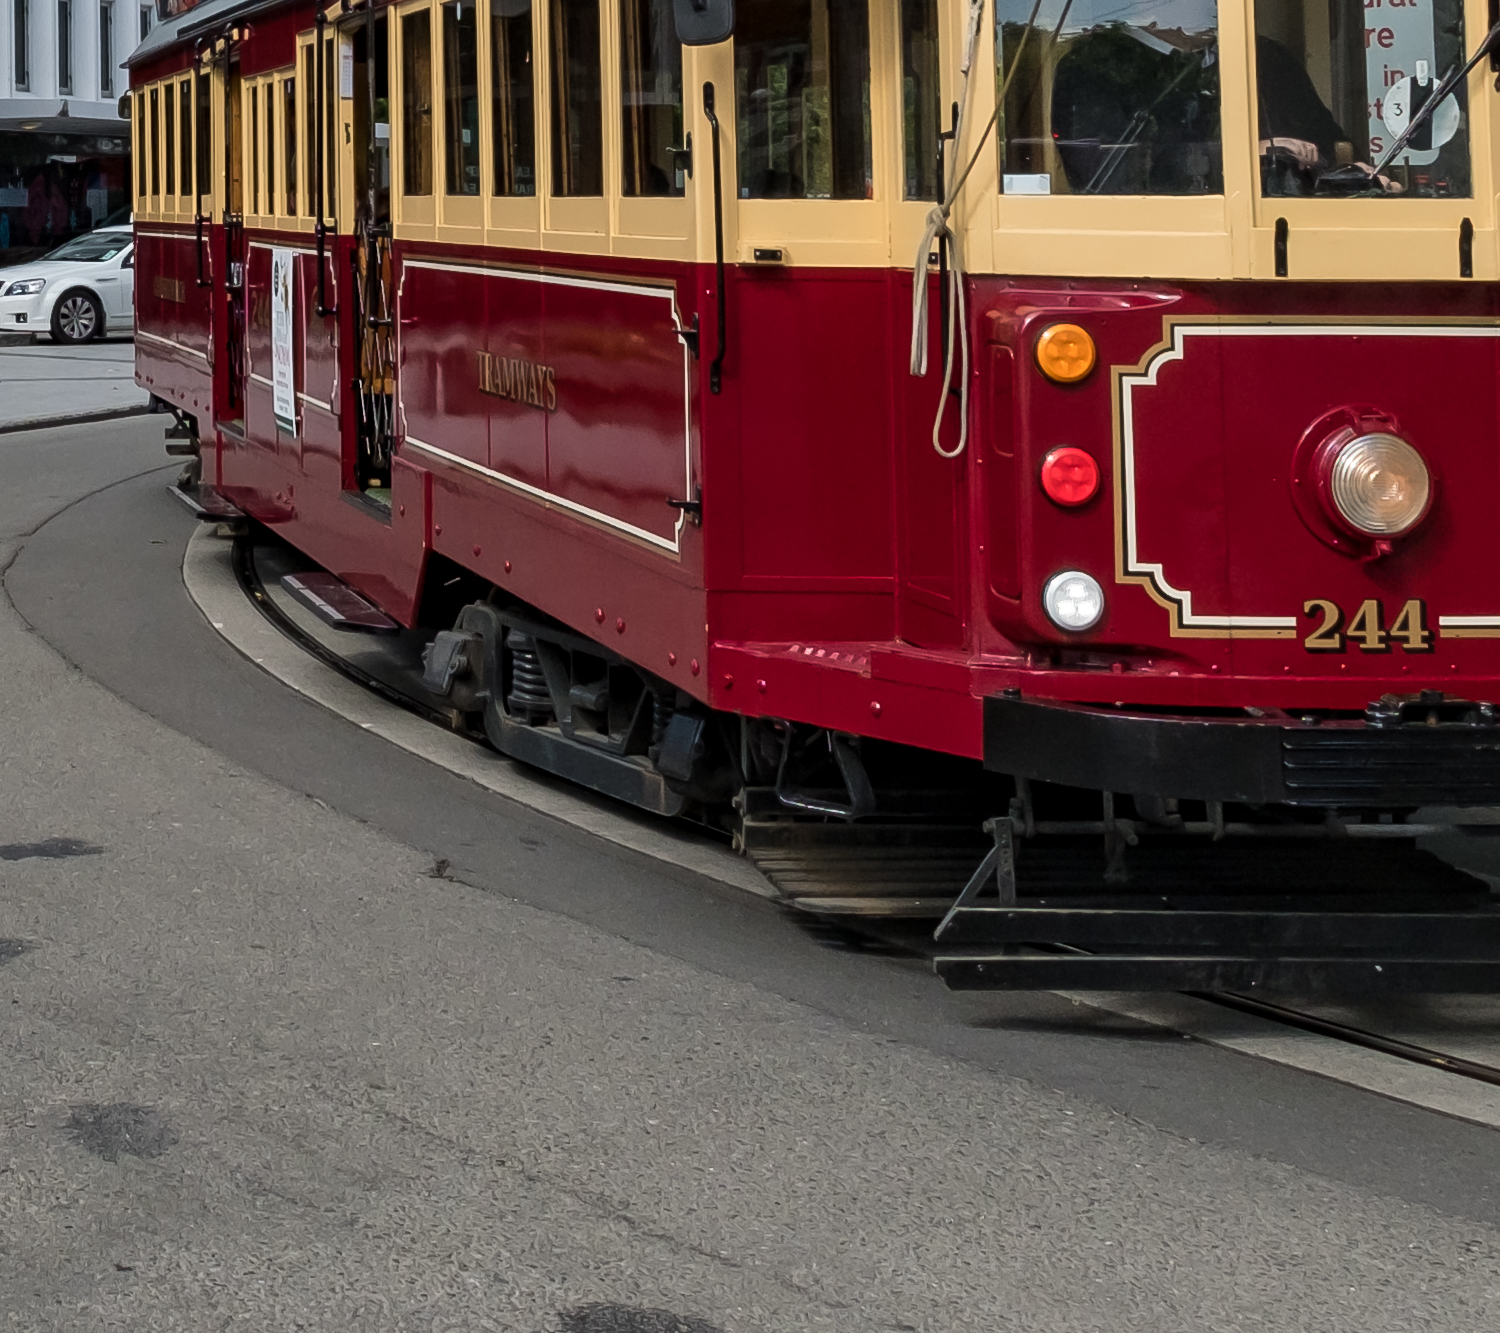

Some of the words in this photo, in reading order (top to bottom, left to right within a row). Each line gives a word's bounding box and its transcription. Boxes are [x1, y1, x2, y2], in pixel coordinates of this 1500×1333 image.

[1393, 102, 1403, 116] 3
[476, 350, 557, 411] TRAMWAYS
[1303, 599, 1431, 651] 244
